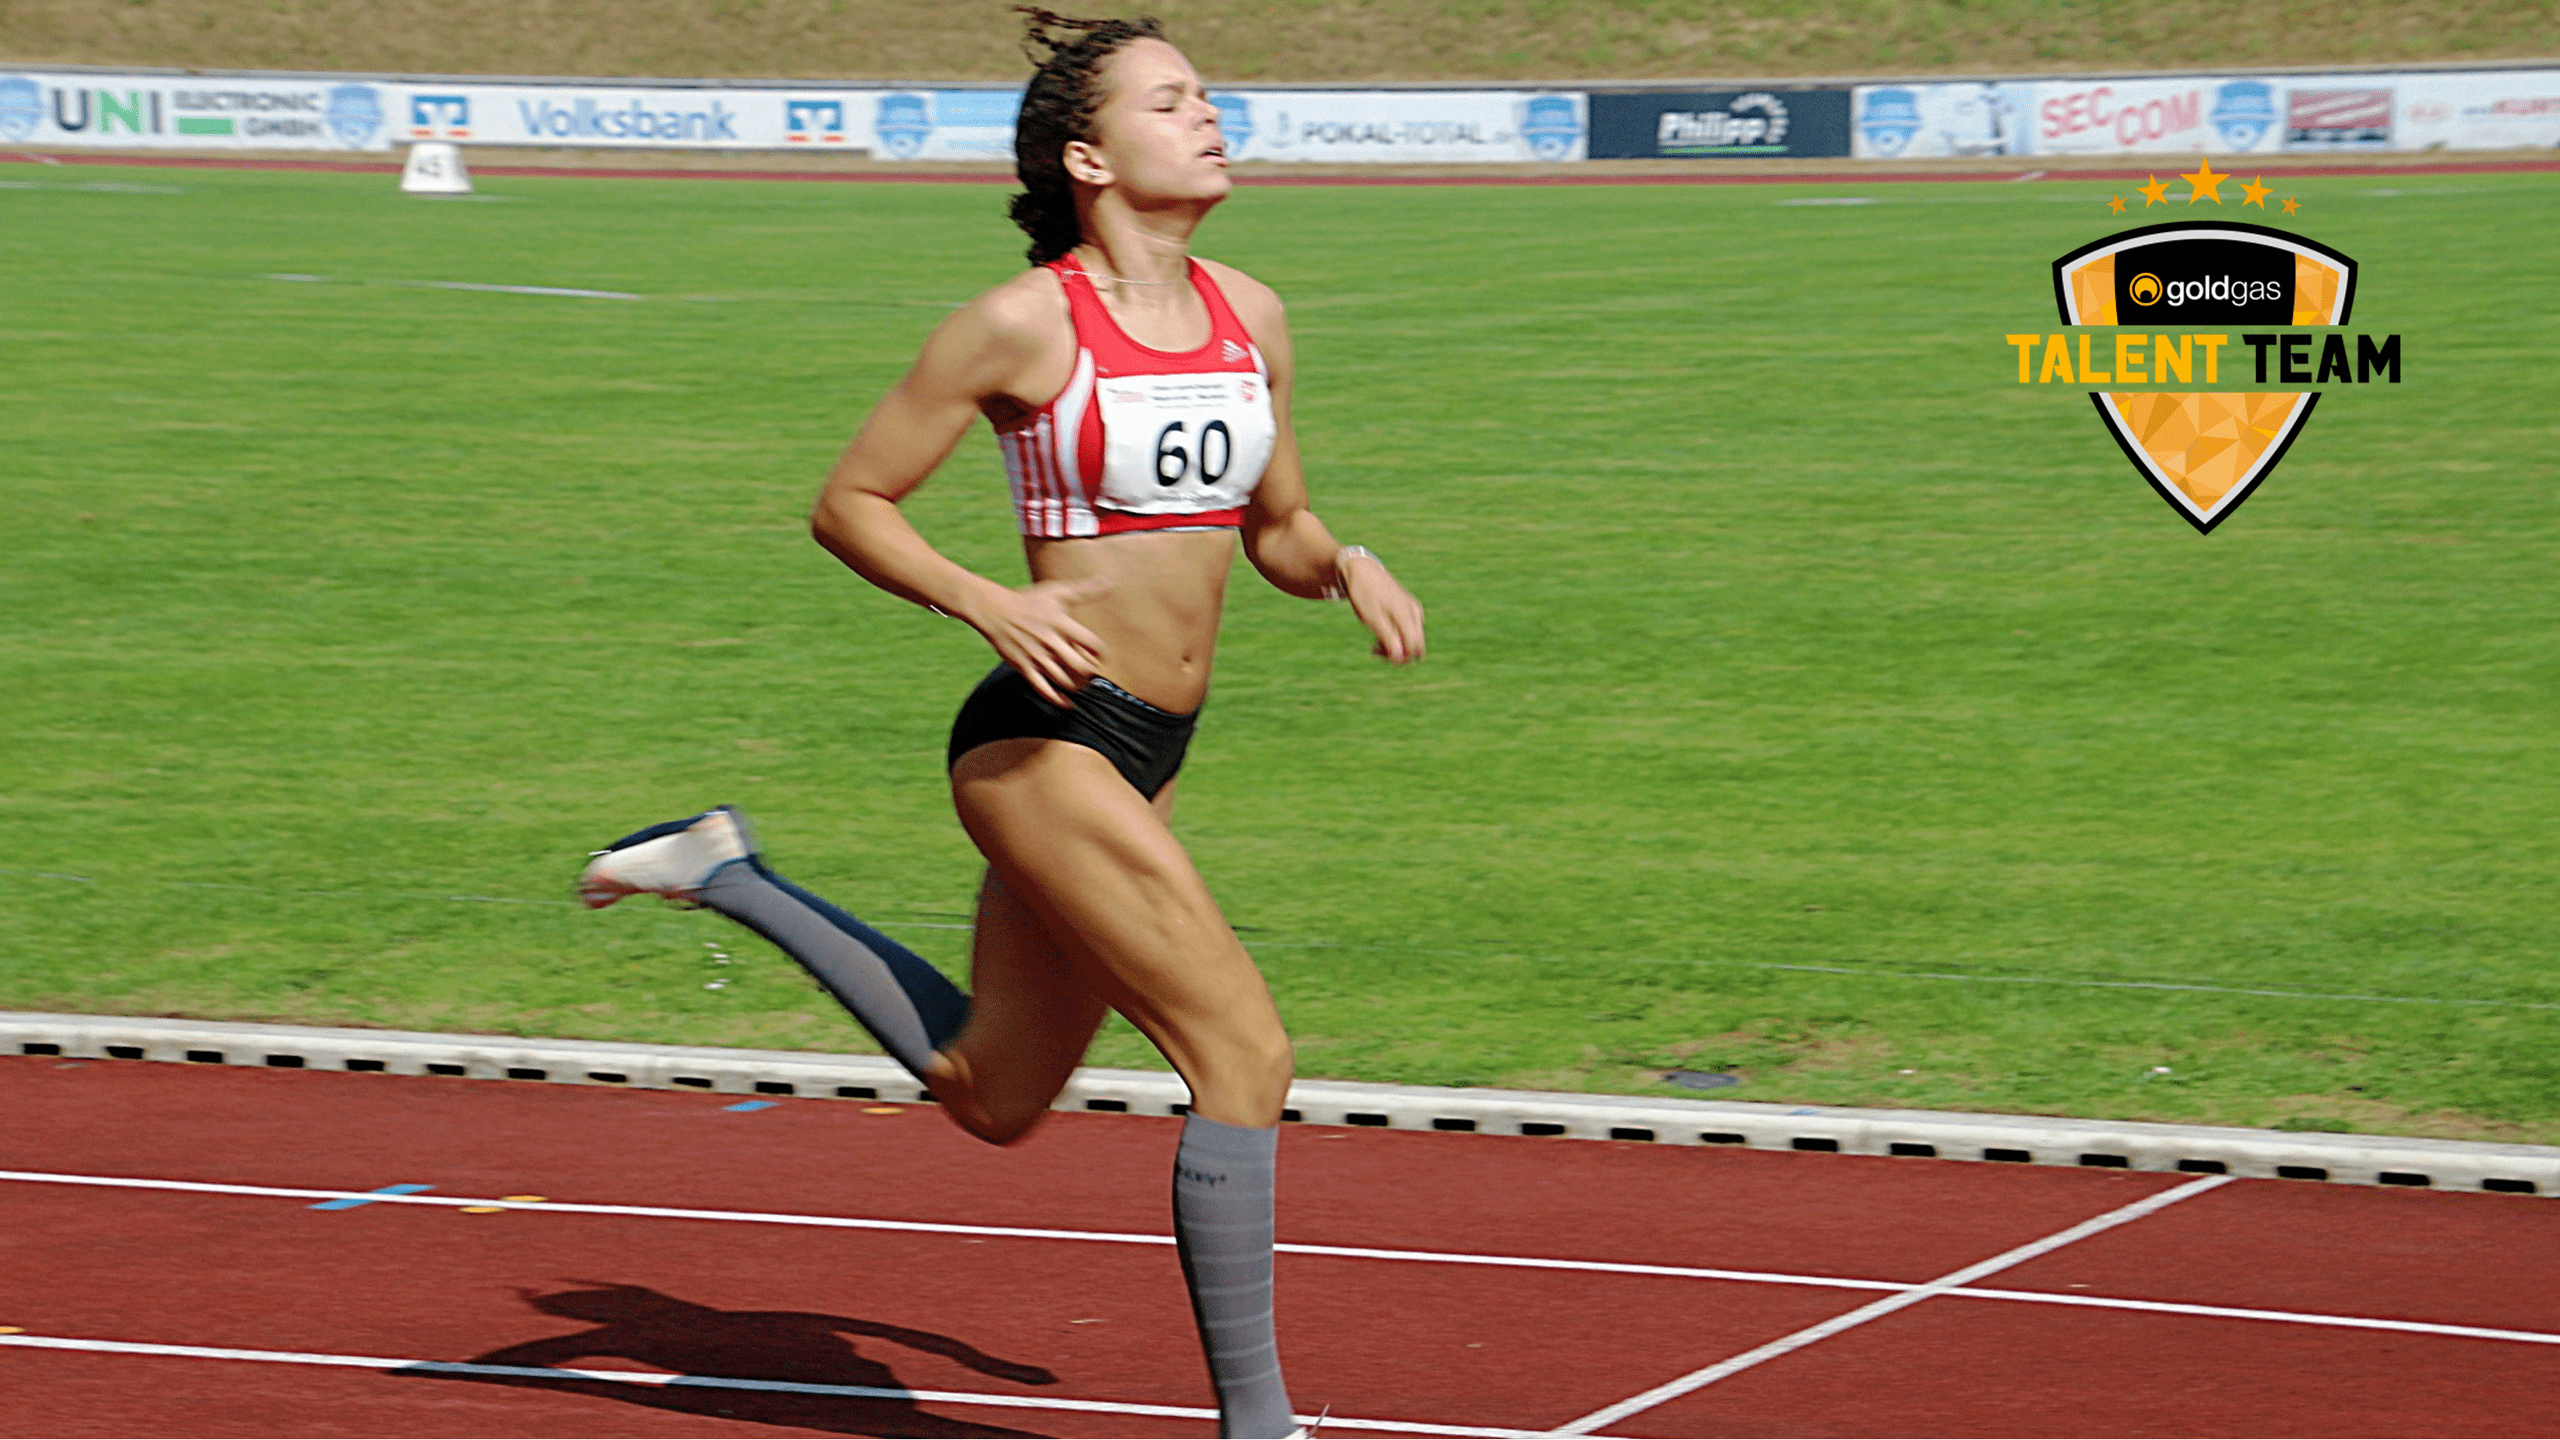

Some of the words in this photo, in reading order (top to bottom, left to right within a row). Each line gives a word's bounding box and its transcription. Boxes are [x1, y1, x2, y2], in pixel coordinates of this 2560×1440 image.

[52, 88, 164, 134] UNI
[516, 98, 739, 139] Volksbank
[1156, 420, 1230, 487] 60
